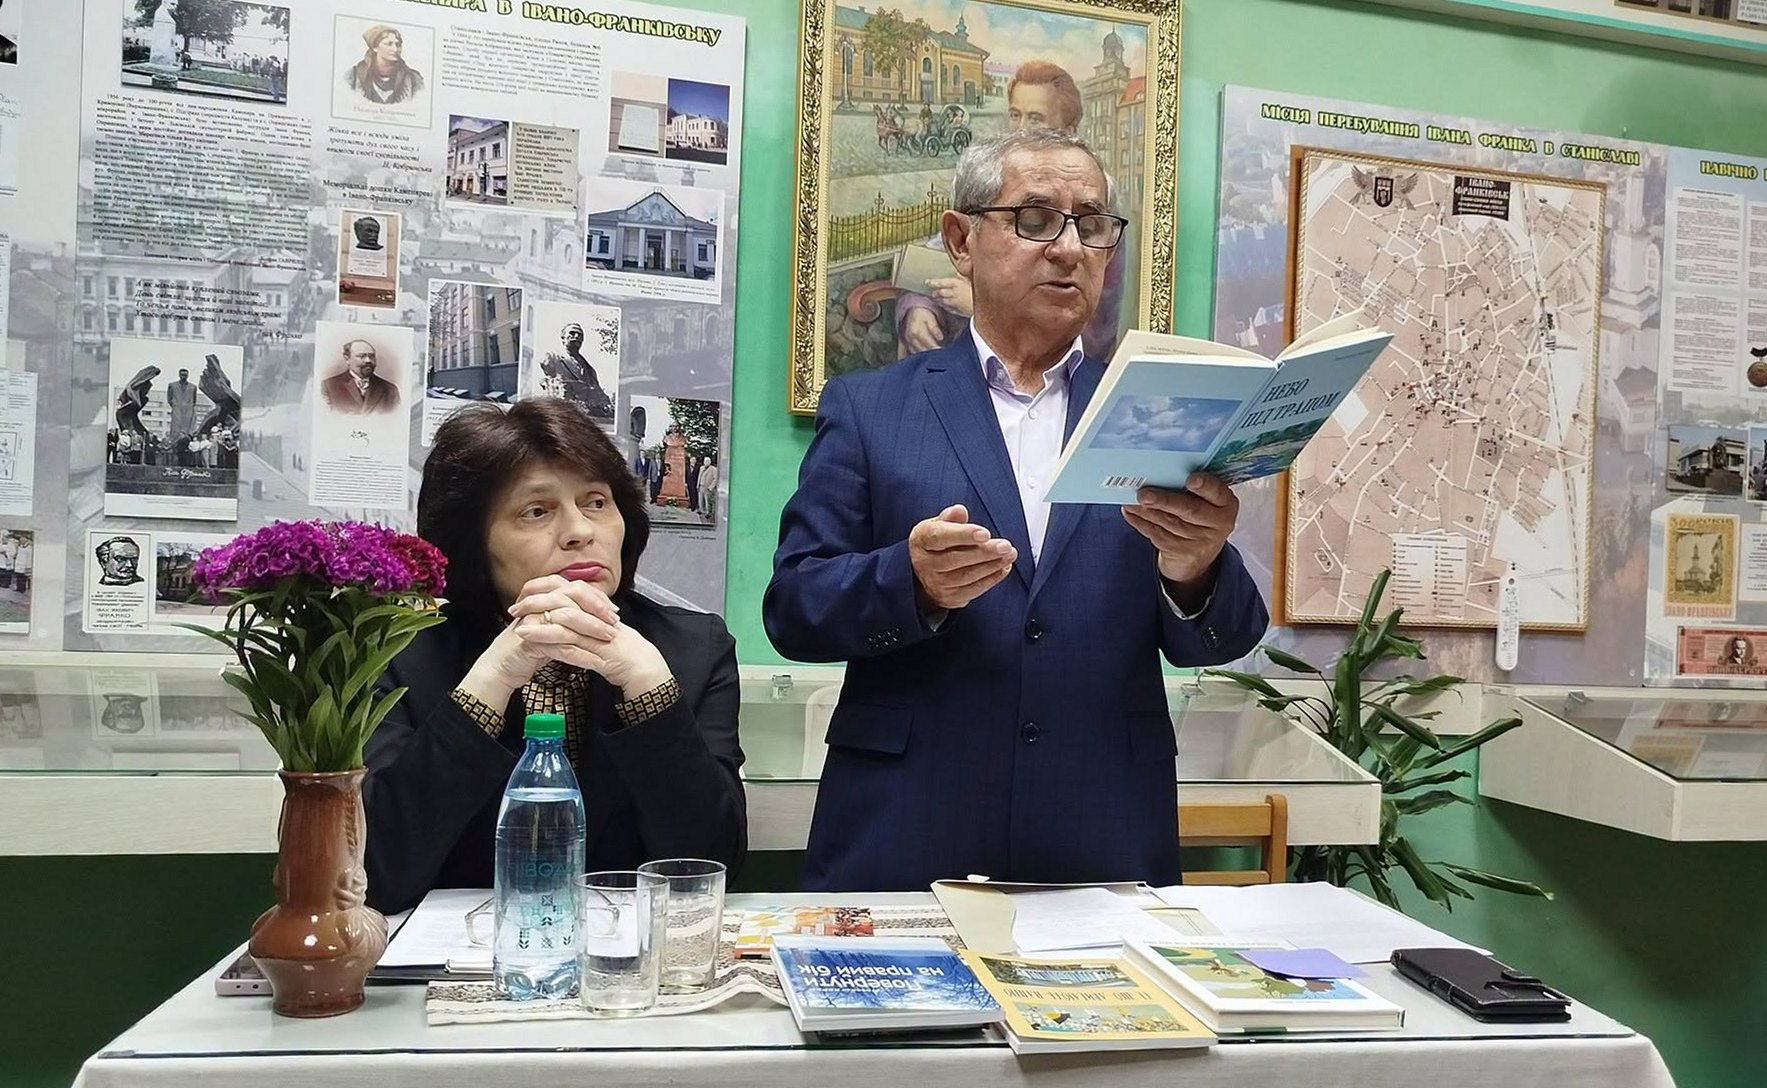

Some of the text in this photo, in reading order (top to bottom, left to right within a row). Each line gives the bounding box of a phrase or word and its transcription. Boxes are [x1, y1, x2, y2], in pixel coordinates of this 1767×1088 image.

[497, 0, 722, 46] В ІВАНО-ФРАНКІВСЬКУ
[1261, 103, 1641, 165] МІСЦЯ ПЕРЕБУВАННЯ ІВАНА ФРАНКА В СТАНІСЛАВІ
[1700, 160, 1758, 180] НАВІЧНО
[1455, 185, 1509, 199] ФРАНКІВСЬК
[1469, 177, 1497, 189] ІВАНО-
[1262, 377, 1311, 403] НЕБО
[1272, 390, 1342, 421] ТРАПОМ
[797, 964, 944, 978] на правий бік
[803, 974, 924, 992] Повернути
